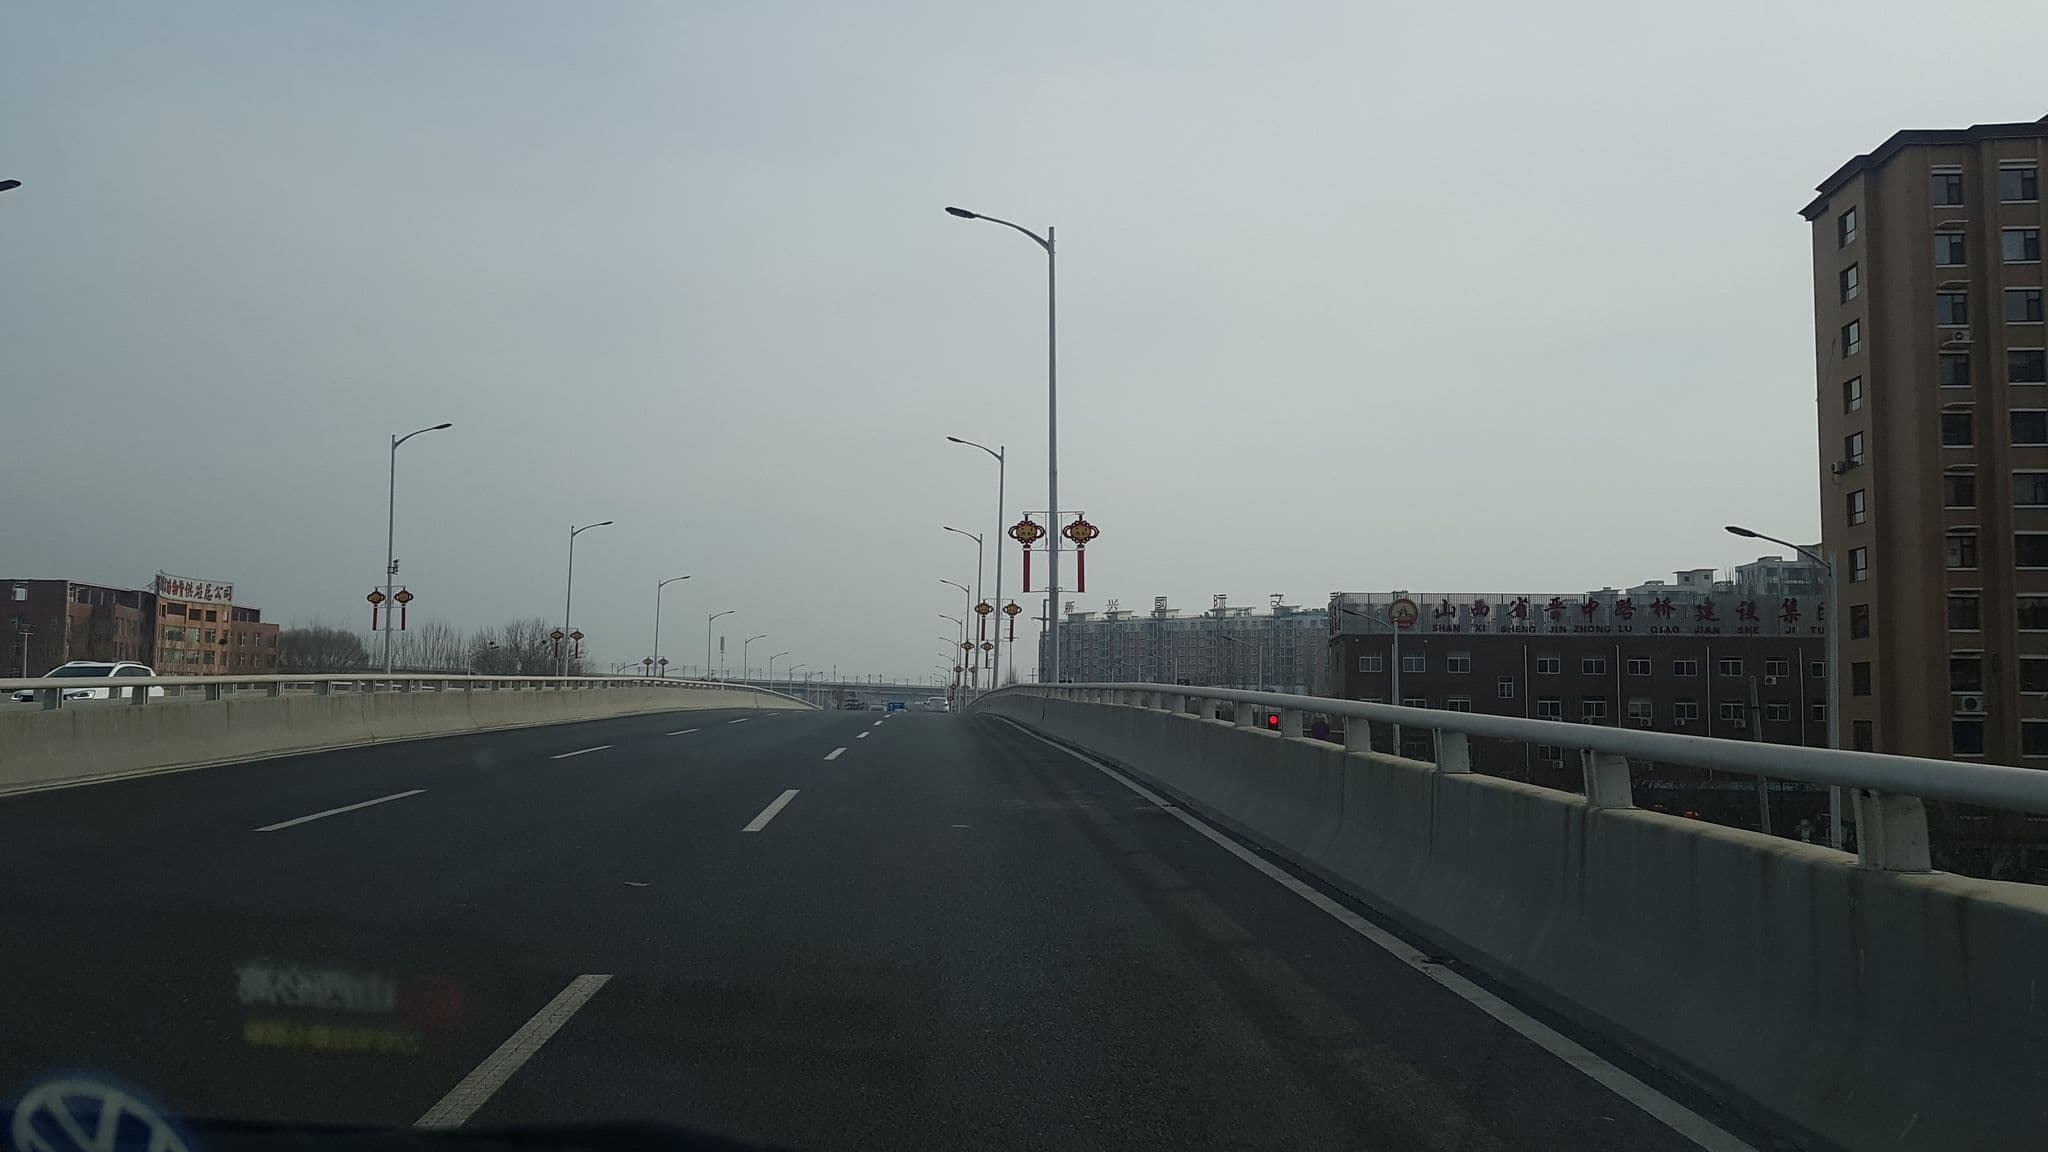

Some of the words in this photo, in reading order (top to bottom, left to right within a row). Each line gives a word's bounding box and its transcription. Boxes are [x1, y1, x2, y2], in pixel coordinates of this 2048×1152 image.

[1432, 624, 1461, 633] SHAN
[1475, 624, 1486, 632] XI
[1501, 625, 1536, 634] SHENG
[1549, 625, 1567, 633] JIN
[1574, 625, 1611, 633] ZHONG
[1618, 625, 1632, 633] LU
[1650, 626, 1680, 634] QIAO
[1695, 626, 1720, 634] JIAN
[1737, 626, 1760, 634] SHE
[1785, 626, 1796, 634] JI
